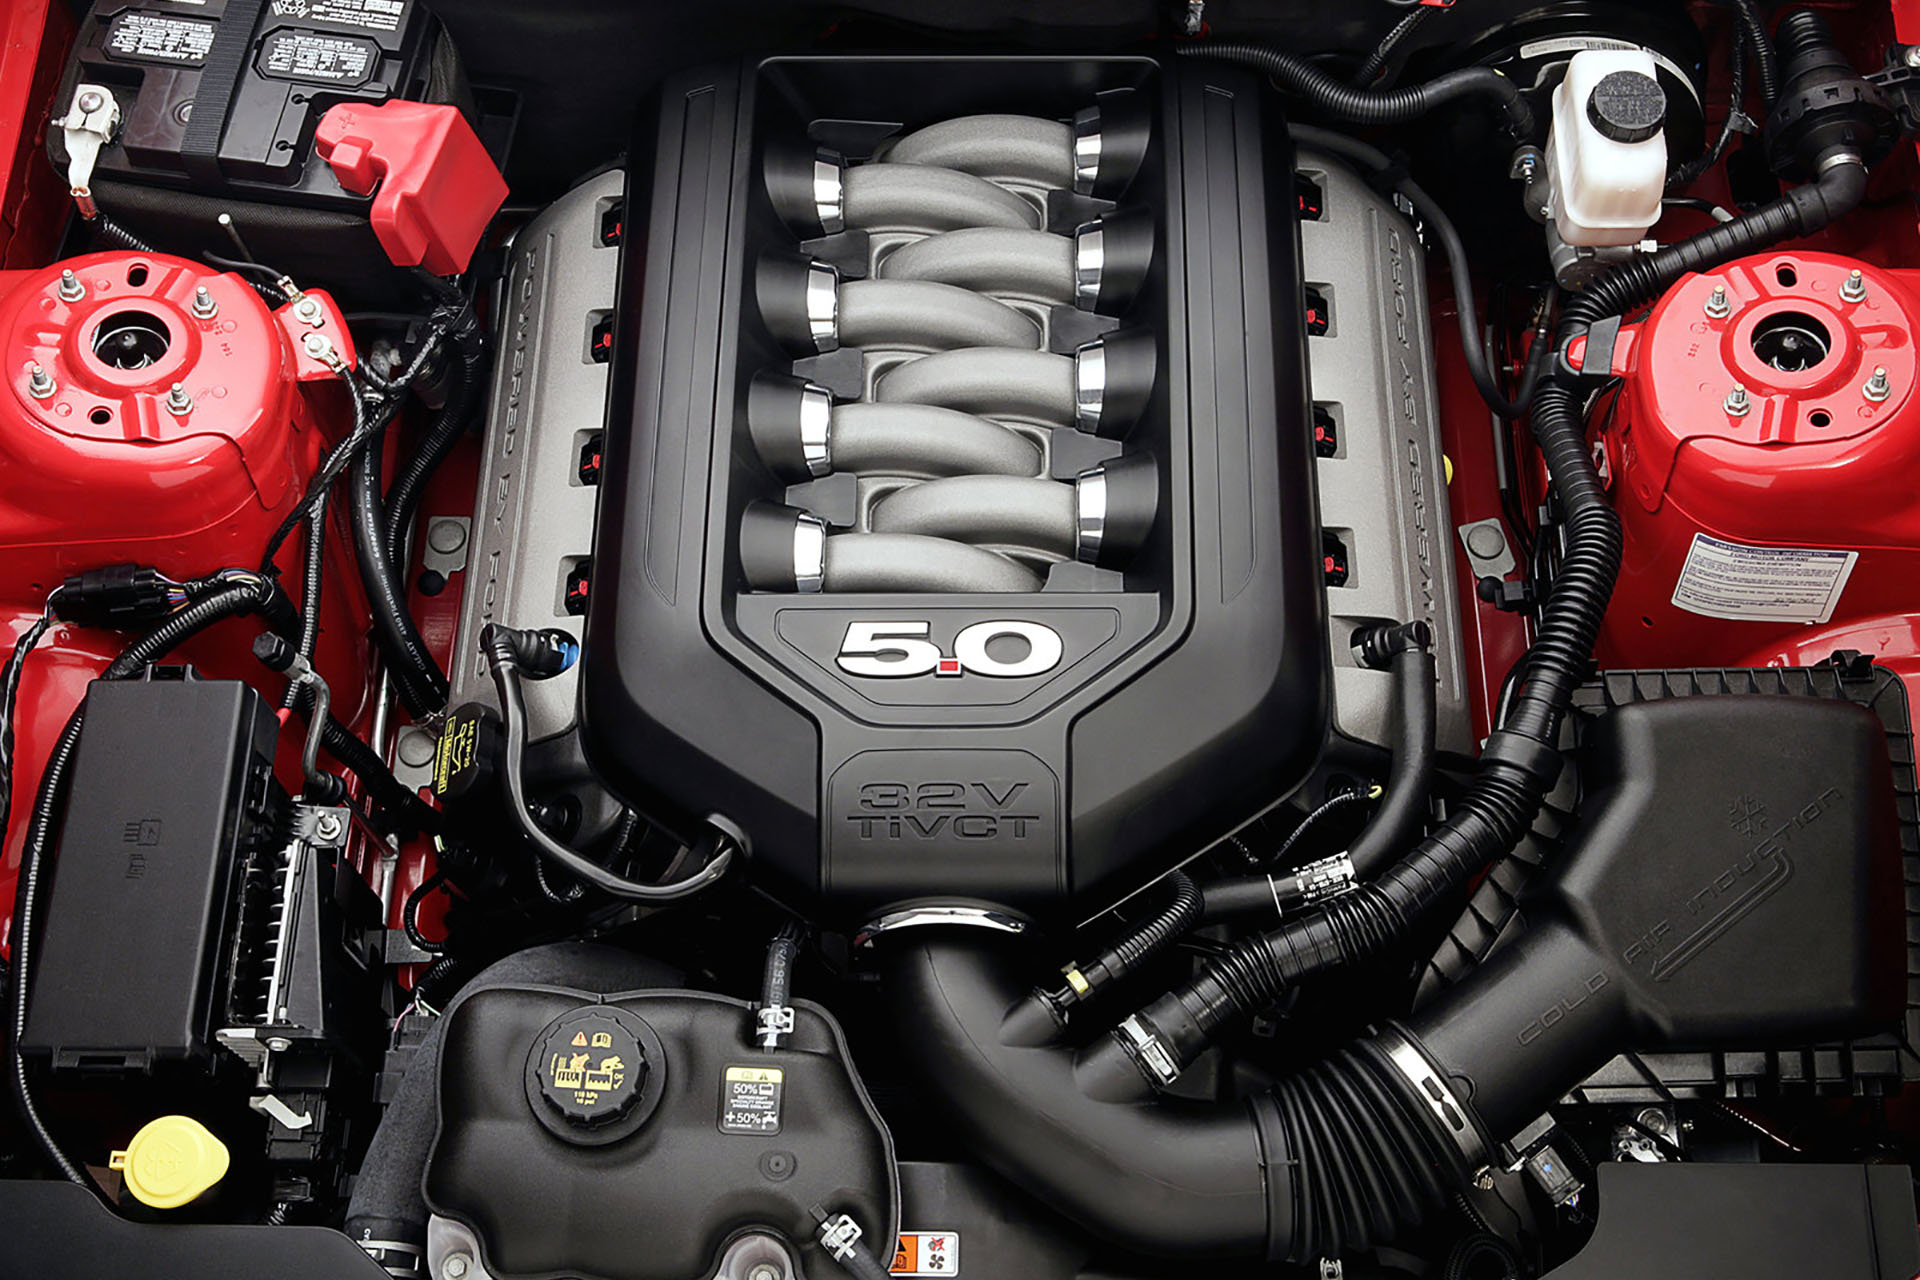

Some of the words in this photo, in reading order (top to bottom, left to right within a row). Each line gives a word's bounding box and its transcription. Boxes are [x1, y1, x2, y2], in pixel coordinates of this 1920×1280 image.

[1388, 227, 1411, 350] FORD
[503, 247, 538, 460] POWERED
[1400, 357, 1418, 427] BY
[366, 511, 381, 559] GOODYEAR
[491, 472, 511, 536] BY
[835, 619, 1064, 679] 5.0
[858, 781, 1030, 812] 32V
[1516, 970, 1611, 1048] COLD
[1622, 919, 1672, 966] AIR
[733, 1082, 758, 1095] 50%
